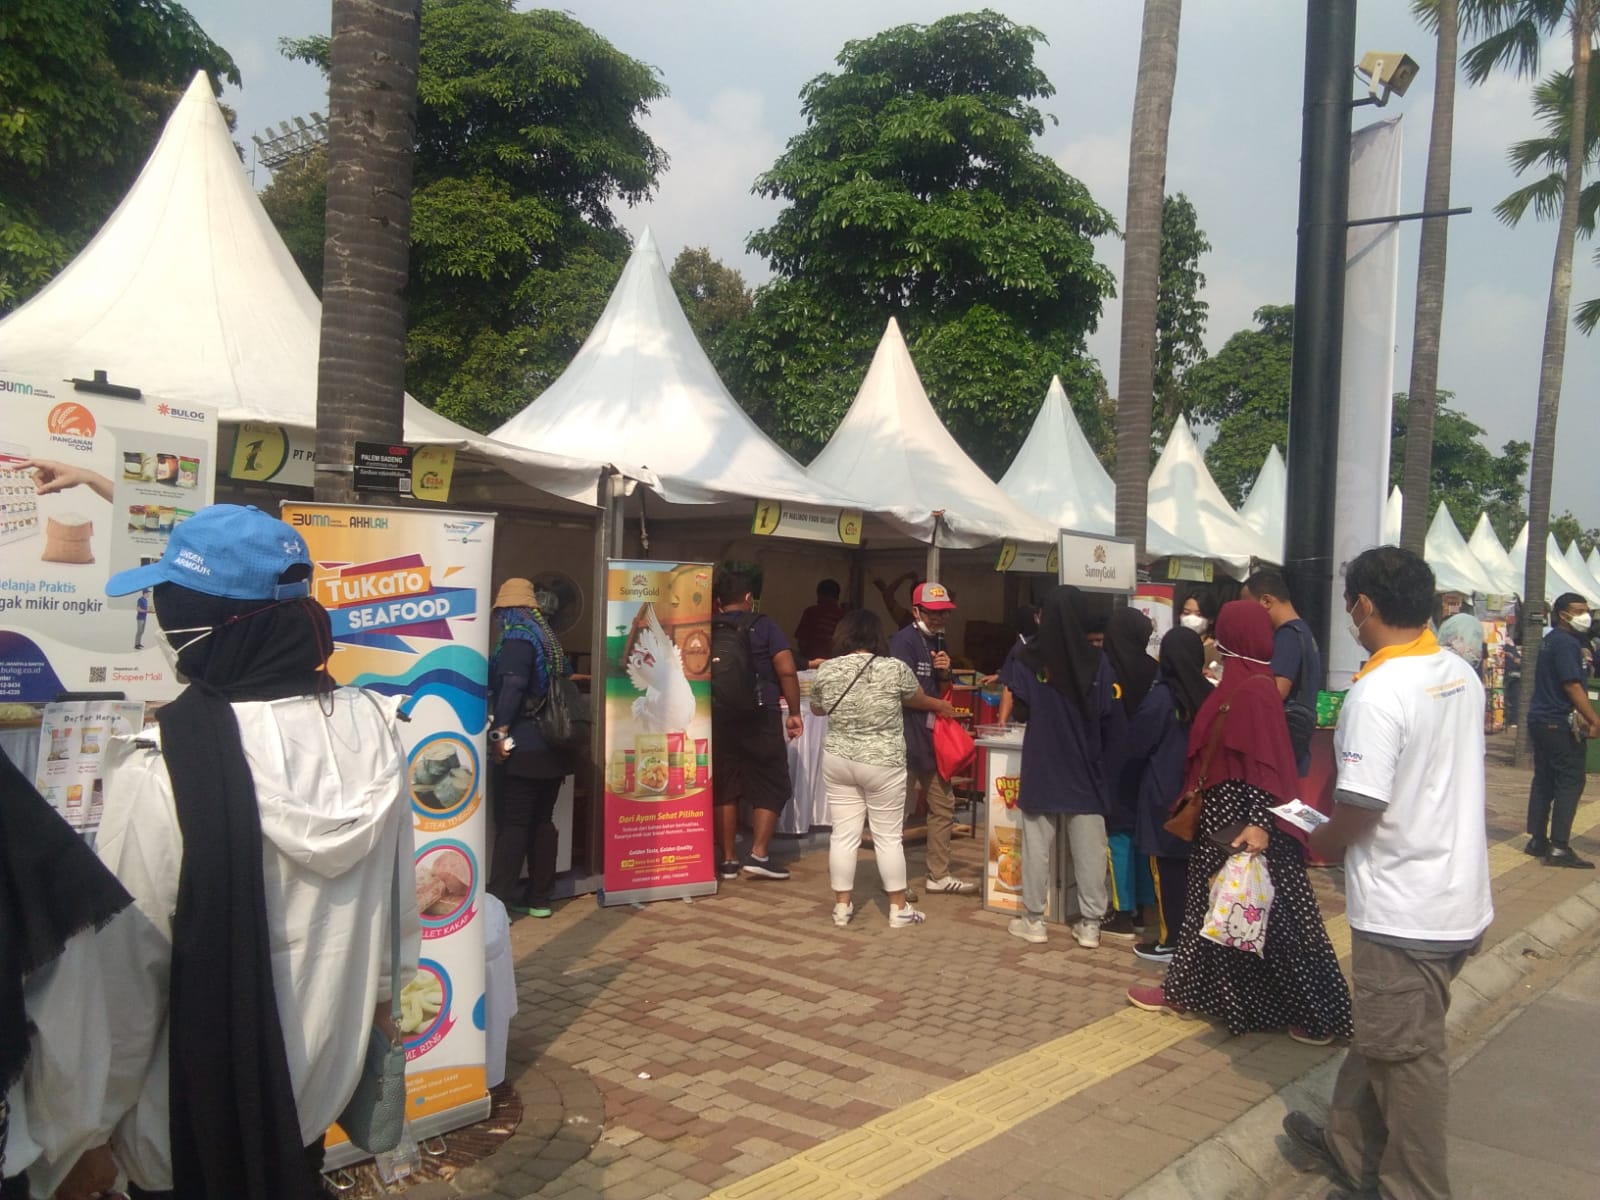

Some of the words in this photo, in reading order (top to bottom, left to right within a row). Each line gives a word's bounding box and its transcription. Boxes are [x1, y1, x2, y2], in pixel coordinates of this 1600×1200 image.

[171, 408, 205, 419] BULOG
[293, 449, 304, 460] PT
[1085, 564, 1116, 582] SunnyGold
[0, 579, 36, 593] elanja
[39, 580, 77, 593] Praktis
[620, 586, 660, 598] SunnyGold
[0, 595, 22, 612] gak
[25, 596, 60, 610] mikir
[62, 598, 103, 615] ongkir
[348, 598, 450, 629] SEAFOOD
[112, 672, 144, 682] Shopee
[145, 672, 163, 680] Mall
[619, 814, 635, 823] Dari
[636, 814, 656, 824] Ayam
[658, 811, 678, 820] Sehat
[679, 809, 704, 818] Pilihan
[420, 1033, 441, 1054] RING
